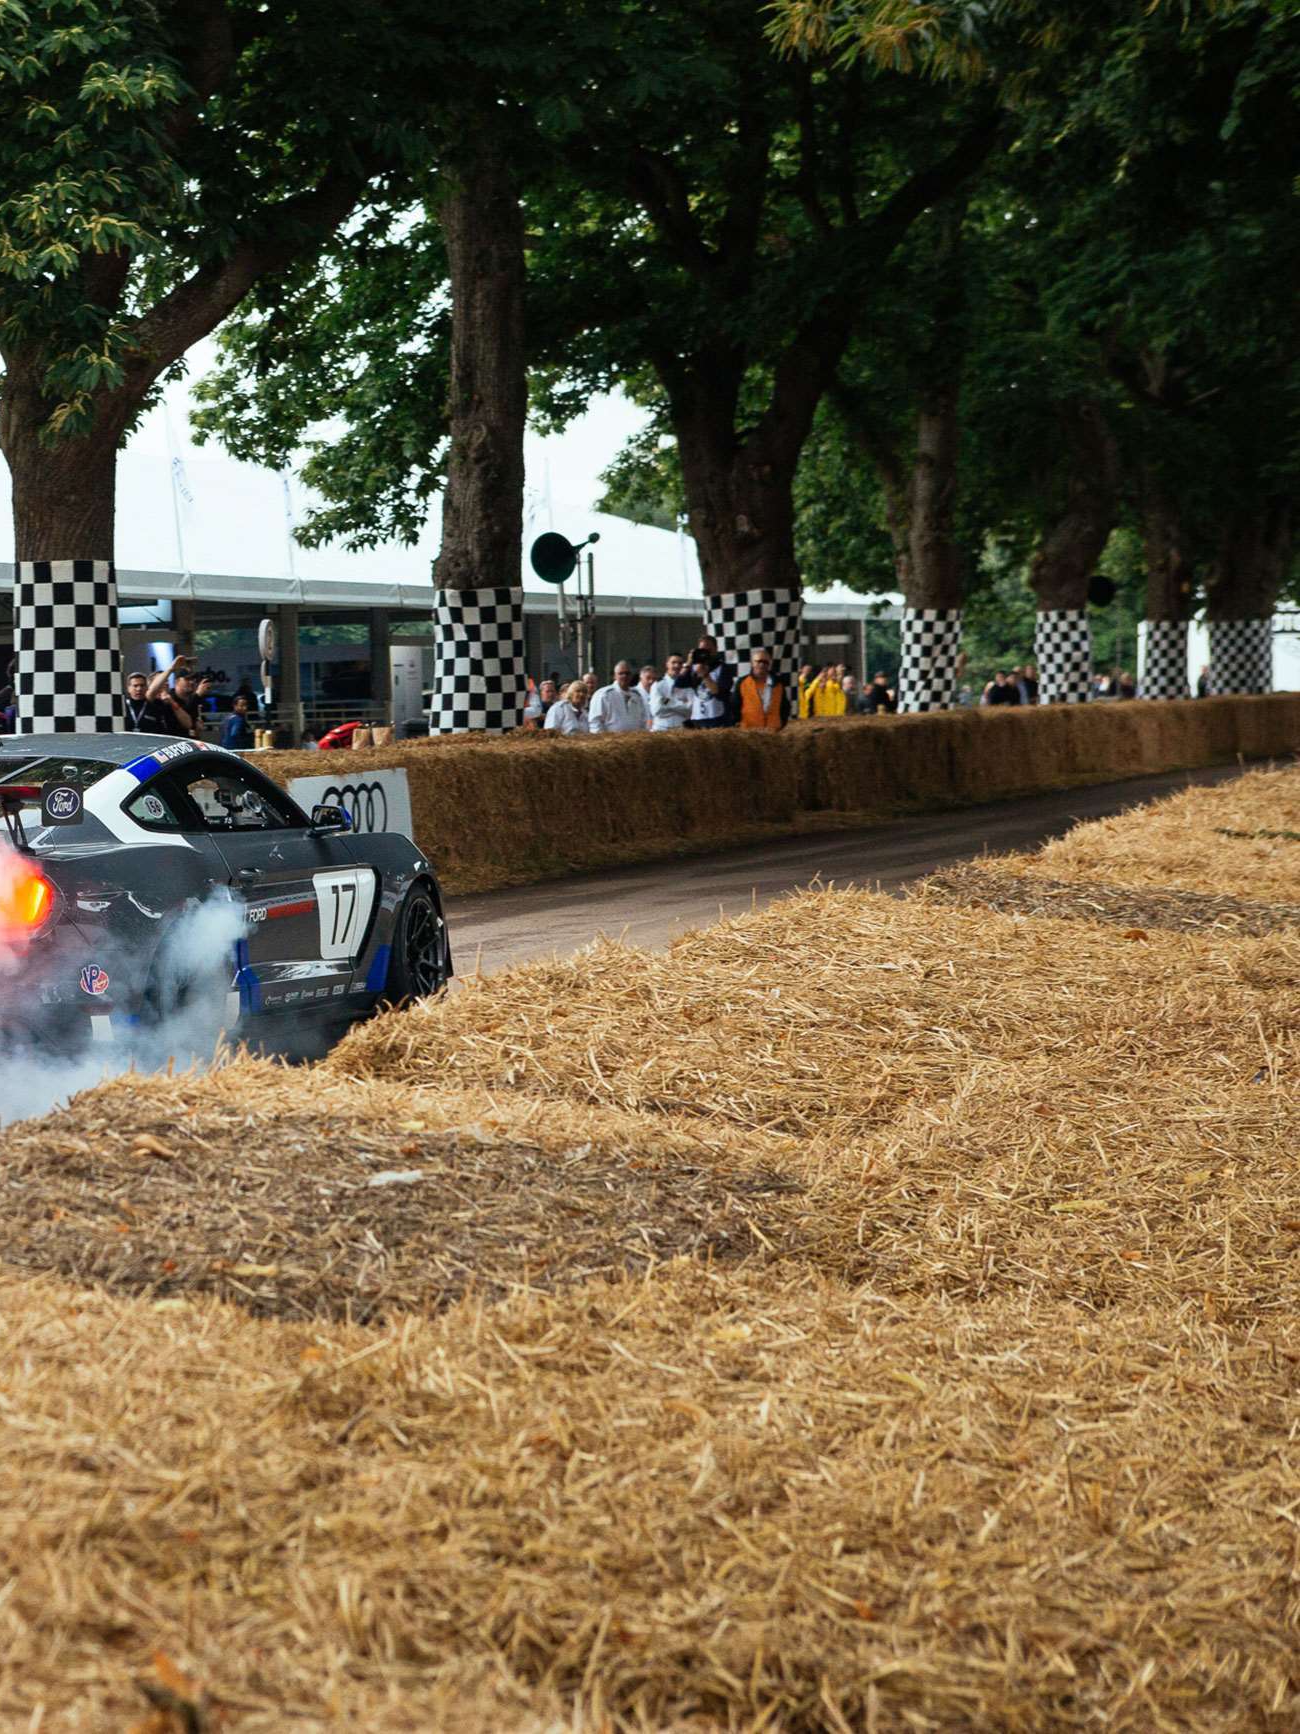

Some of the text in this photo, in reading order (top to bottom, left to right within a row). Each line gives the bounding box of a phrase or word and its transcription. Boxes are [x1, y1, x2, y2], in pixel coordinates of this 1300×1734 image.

[52, 791, 75, 813] Ford
[249, 907, 268, 922] FORD
[331, 884, 356, 946] 17
